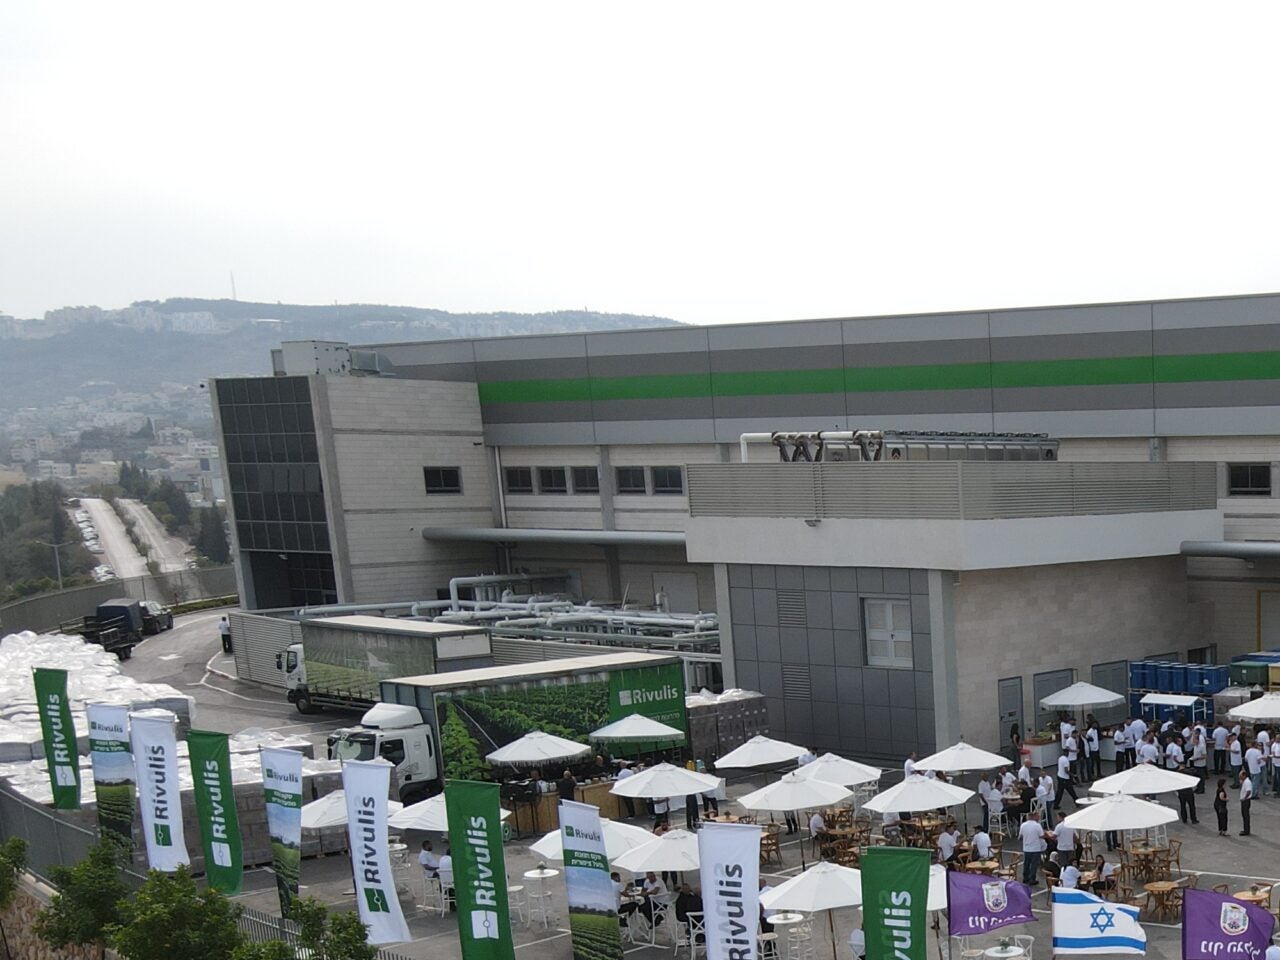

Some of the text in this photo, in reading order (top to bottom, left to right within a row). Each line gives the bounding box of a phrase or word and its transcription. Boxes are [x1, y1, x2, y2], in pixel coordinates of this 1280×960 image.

[47, 693, 70, 762] Rivulis
[632, 685, 678, 704] Rivulis
[149, 745, 169, 819] Rivulis
[204, 760, 228, 839] Rivulis
[357, 796, 382, 884] Rivulis
[468, 816, 497, 906] Rivulis
